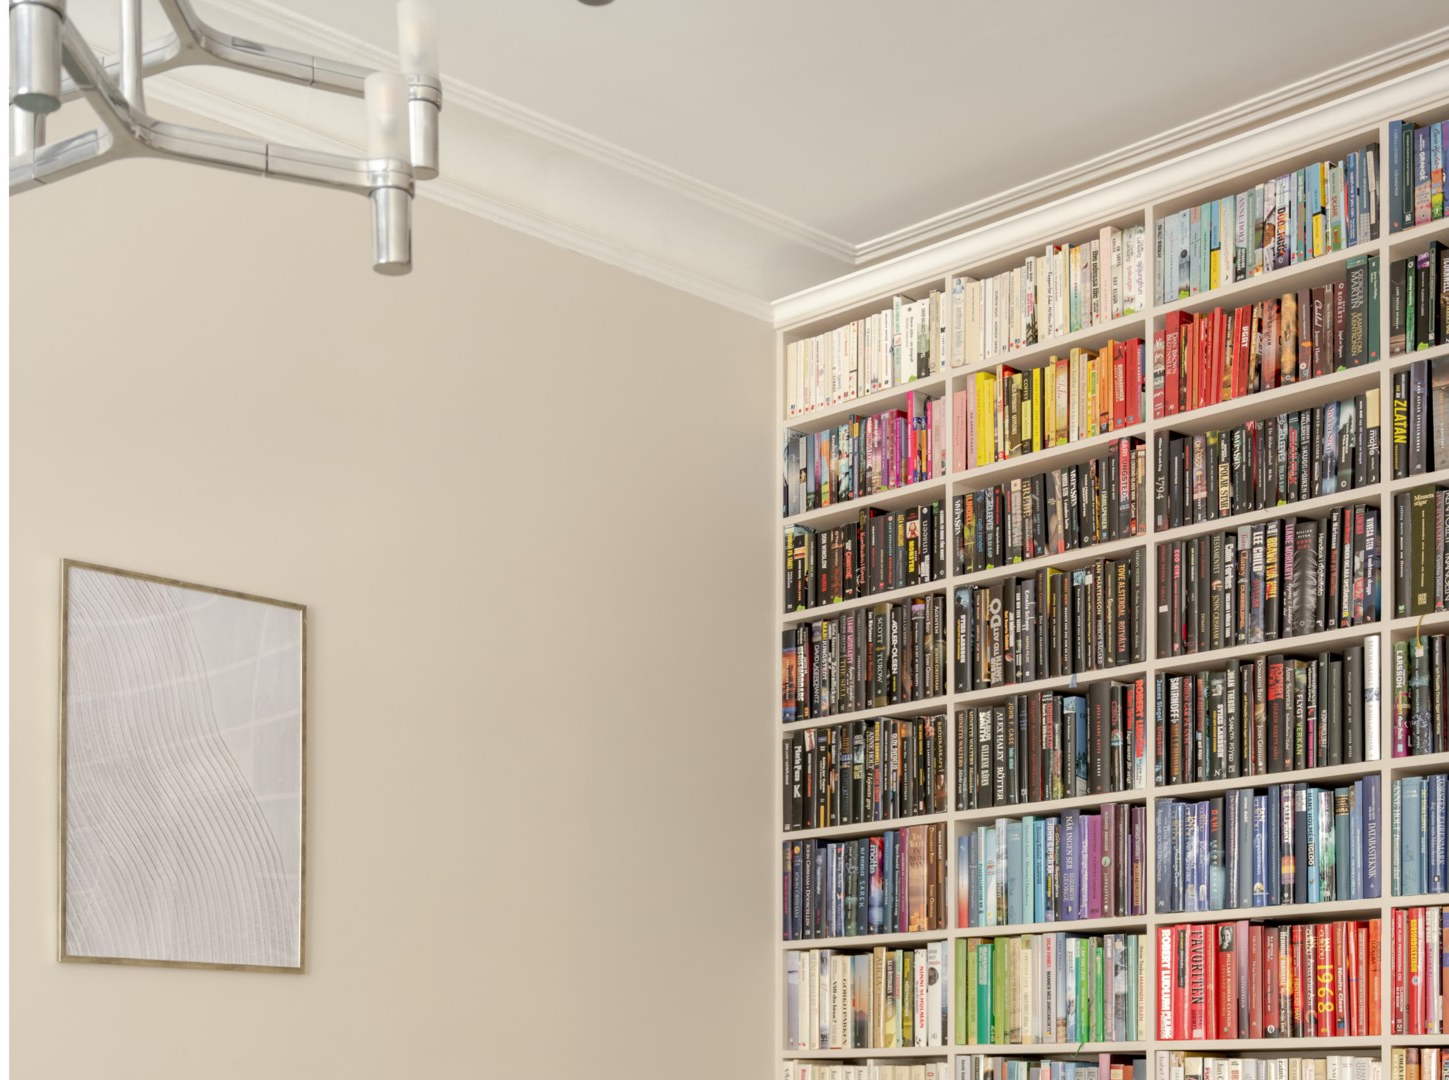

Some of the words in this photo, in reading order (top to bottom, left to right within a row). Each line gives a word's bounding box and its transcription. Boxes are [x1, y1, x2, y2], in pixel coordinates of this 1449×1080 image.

[1419, 152, 1428, 181] GRANGÉ
[1350, 272, 1358, 308] MARTIN
[1394, 399, 1407, 443] ZLATAN
[1156, 476, 1165, 499] 1794
[1221, 465, 1229, 487] POLAR
[1220, 489, 1228, 509] STAR
[1254, 532, 1263, 546] LEE
[1285, 524, 1293, 546] LIANE
[1225, 544, 1234, 562] Colin
[1253, 547, 1263, 572] CHILD
[1266, 537, 1278, 563] BRAVO
[1284, 547, 1293, 580] MORIARTY
[1118, 564, 1126, 581] TOVE
[1225, 564, 1233, 589] Forbes
[1266, 564, 1278, 579] TVÅ
[1118, 582, 1126, 617] ALSTERDAL
[1118, 620, 1126, 653] ROTVÄLTA
[1212, 612, 1220, 639] GRISHAM
[1135, 680, 1144, 717] ROBERT
[1170, 678, 1180, 719] SMIRNOFF
[1136, 719, 1145, 758] LUDLUM
[794, 746, 802, 764] Mario
[997, 767, 1005, 800] RÖTTER
[1066, 816, 1075, 832] NÄR
[1368, 822, 1376, 878] DATABASTEKNIK
[1161, 930, 1170, 968] ROBERT
[1192, 930, 1203, 1004] FAVORITEN
[1161, 969, 1170, 1011] LUDLUM
[1317, 964, 1334, 1013] 1968
[1216, 1062, 1225, 1074] Jan
